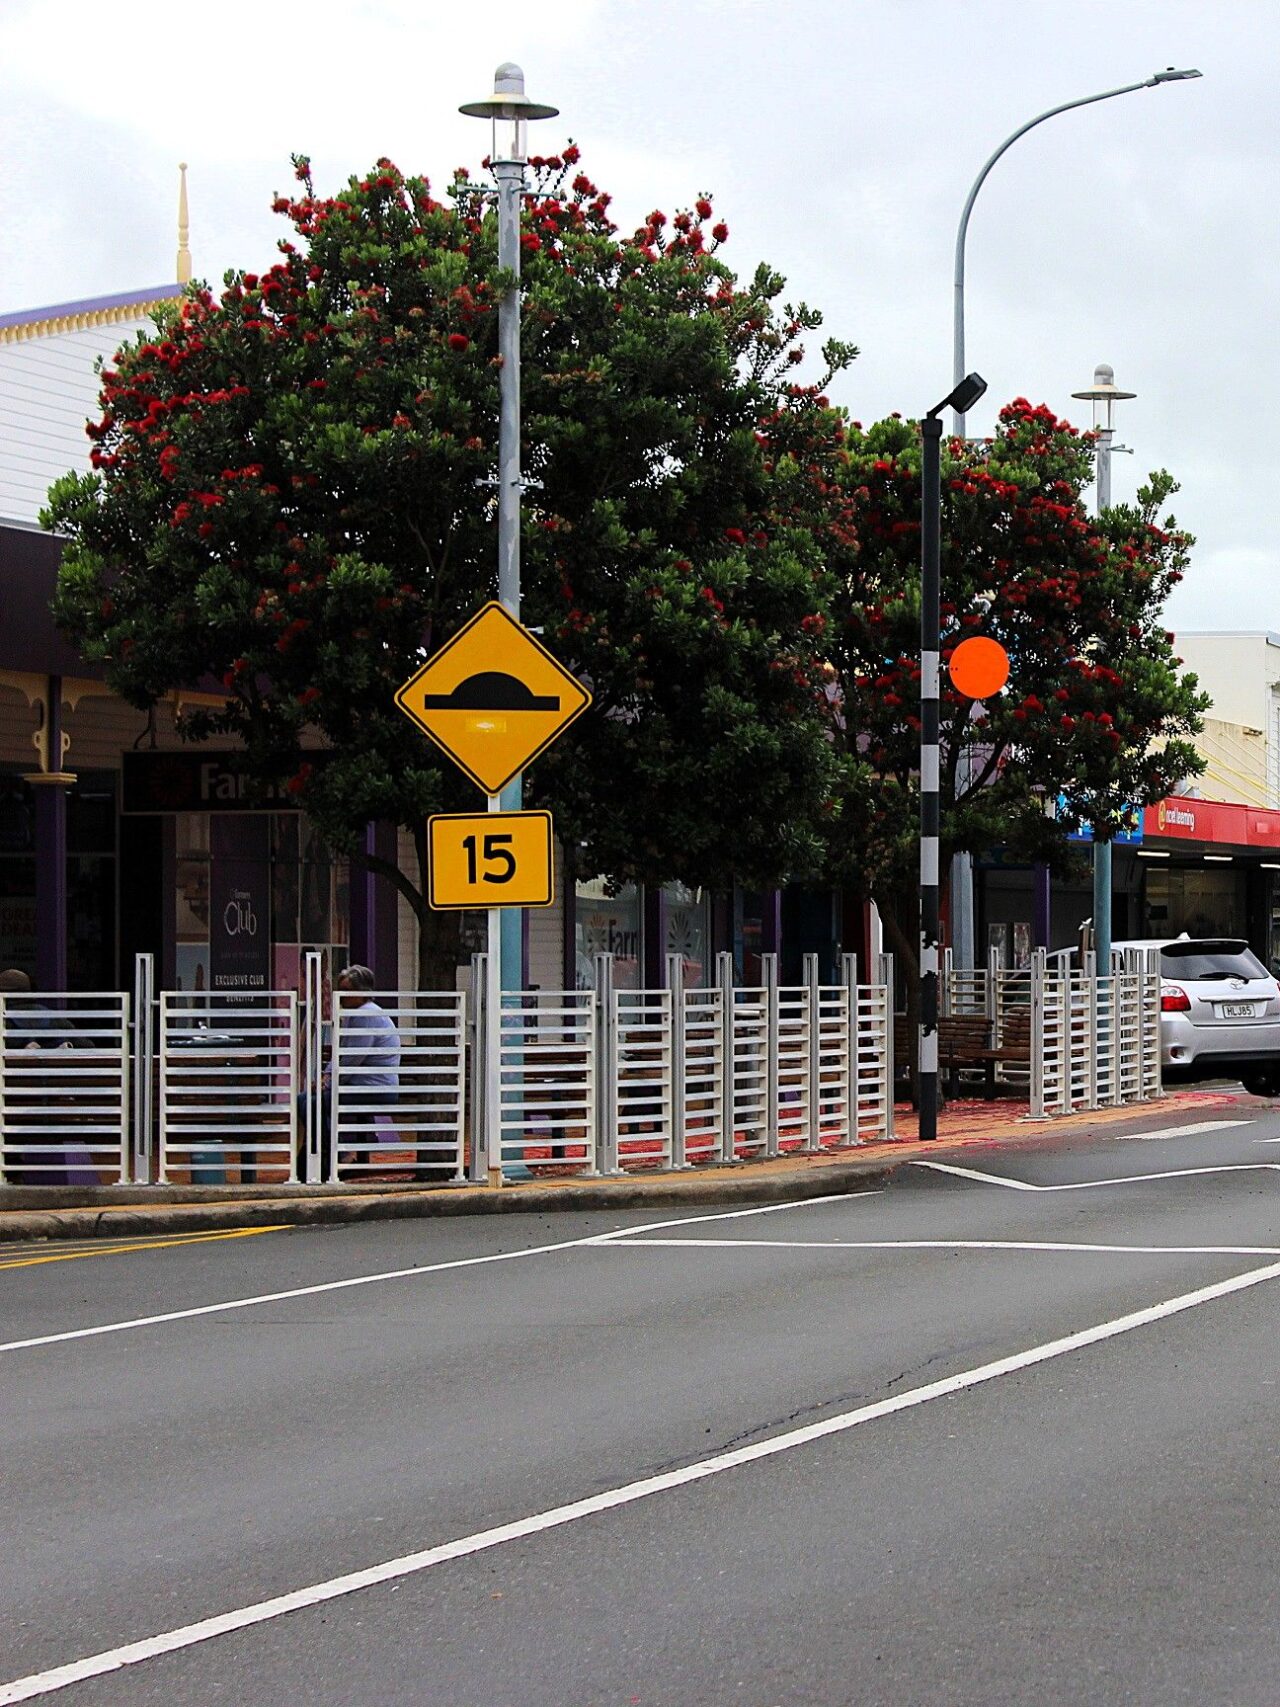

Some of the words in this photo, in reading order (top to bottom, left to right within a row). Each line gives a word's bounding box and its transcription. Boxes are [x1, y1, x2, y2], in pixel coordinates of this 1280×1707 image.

[462, 834, 517, 884] 15
[223, 901, 257, 936] Club
[215, 975, 248, 985] EXCLUSIVE
[249, 975, 264, 985] CLUB
[1227, 1005, 1252, 1017] HLJ85
